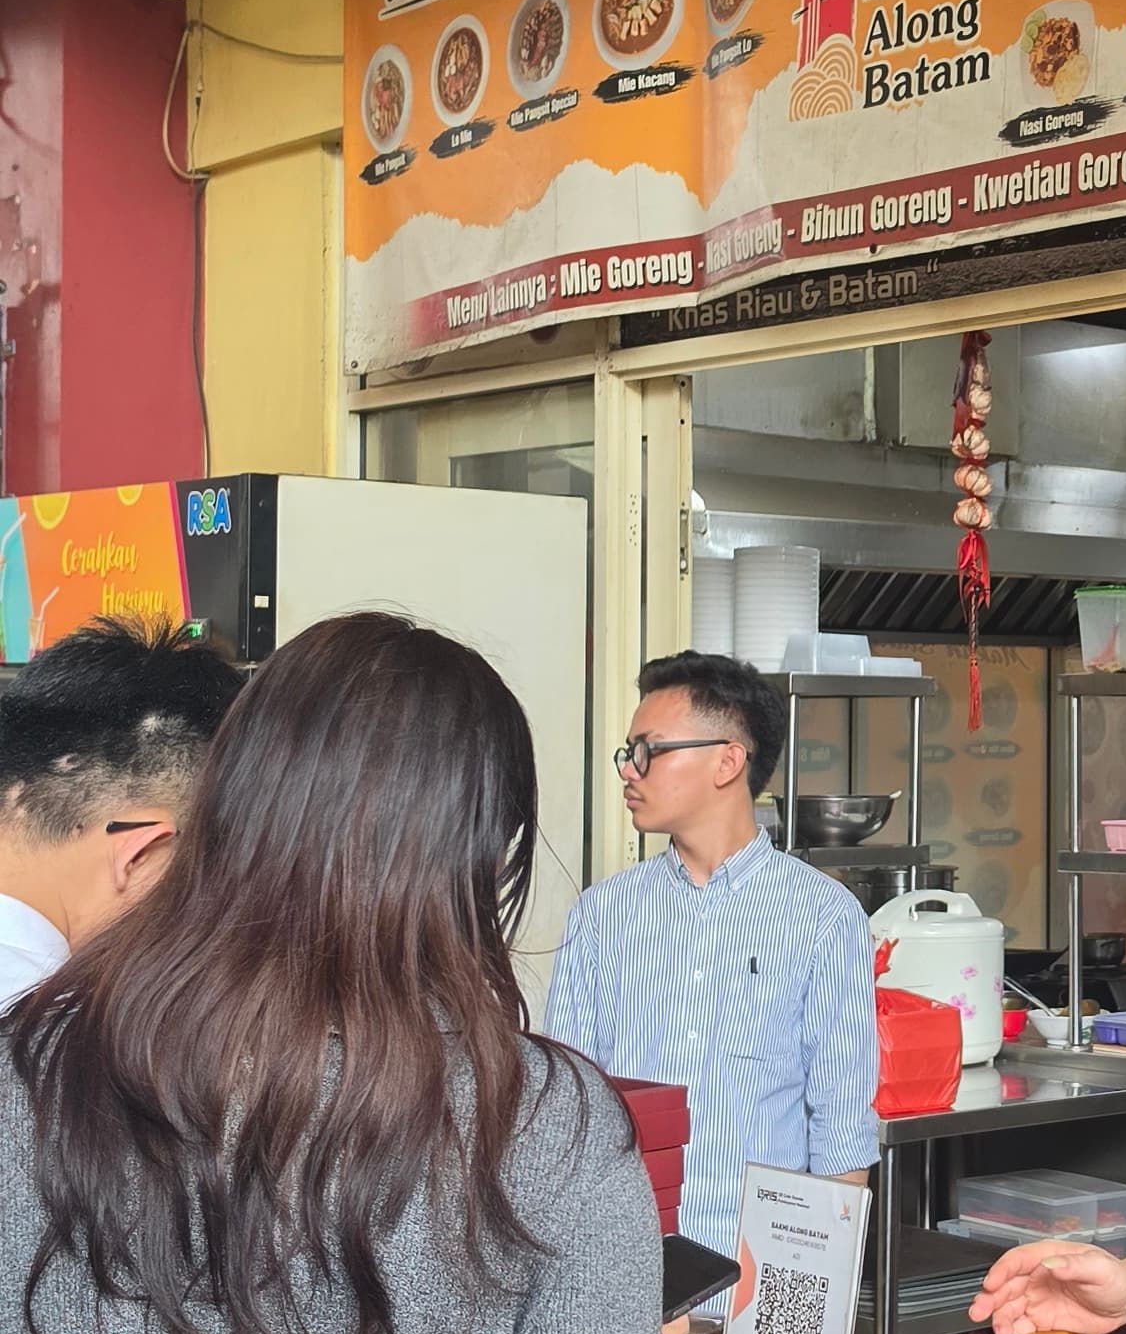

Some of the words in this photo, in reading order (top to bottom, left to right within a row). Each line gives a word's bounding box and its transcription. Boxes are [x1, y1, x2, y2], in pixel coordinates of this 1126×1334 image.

[618, 77, 636, 94] Mie
[638, 71, 676, 90] Kacang
[862, 50, 991, 109] Batam
[1019, 116, 1043, 137] Nasi
[1045, 108, 1084, 133] Goreng
[446, 288, 488, 329] Menu
[488, 274, 547, 316] Lainnya
[560, 258, 602, 298] Mie
[607, 249, 694, 291] Goreng
[706, 231, 732, 275] Nasi
[734, 217, 783, 263] Goreng
[801, 202, 864, 245] Bihun
[870, 184, 952, 230] Goreng
[973, 162, 1071, 213] Kwetiau
[736, 288, 793, 321] Riau
[800, 279, 821, 310] &
[829, 270, 918, 307] Batam
[187, 488, 232, 536] RSA
[61, 532, 138, 579] Cerahkan
